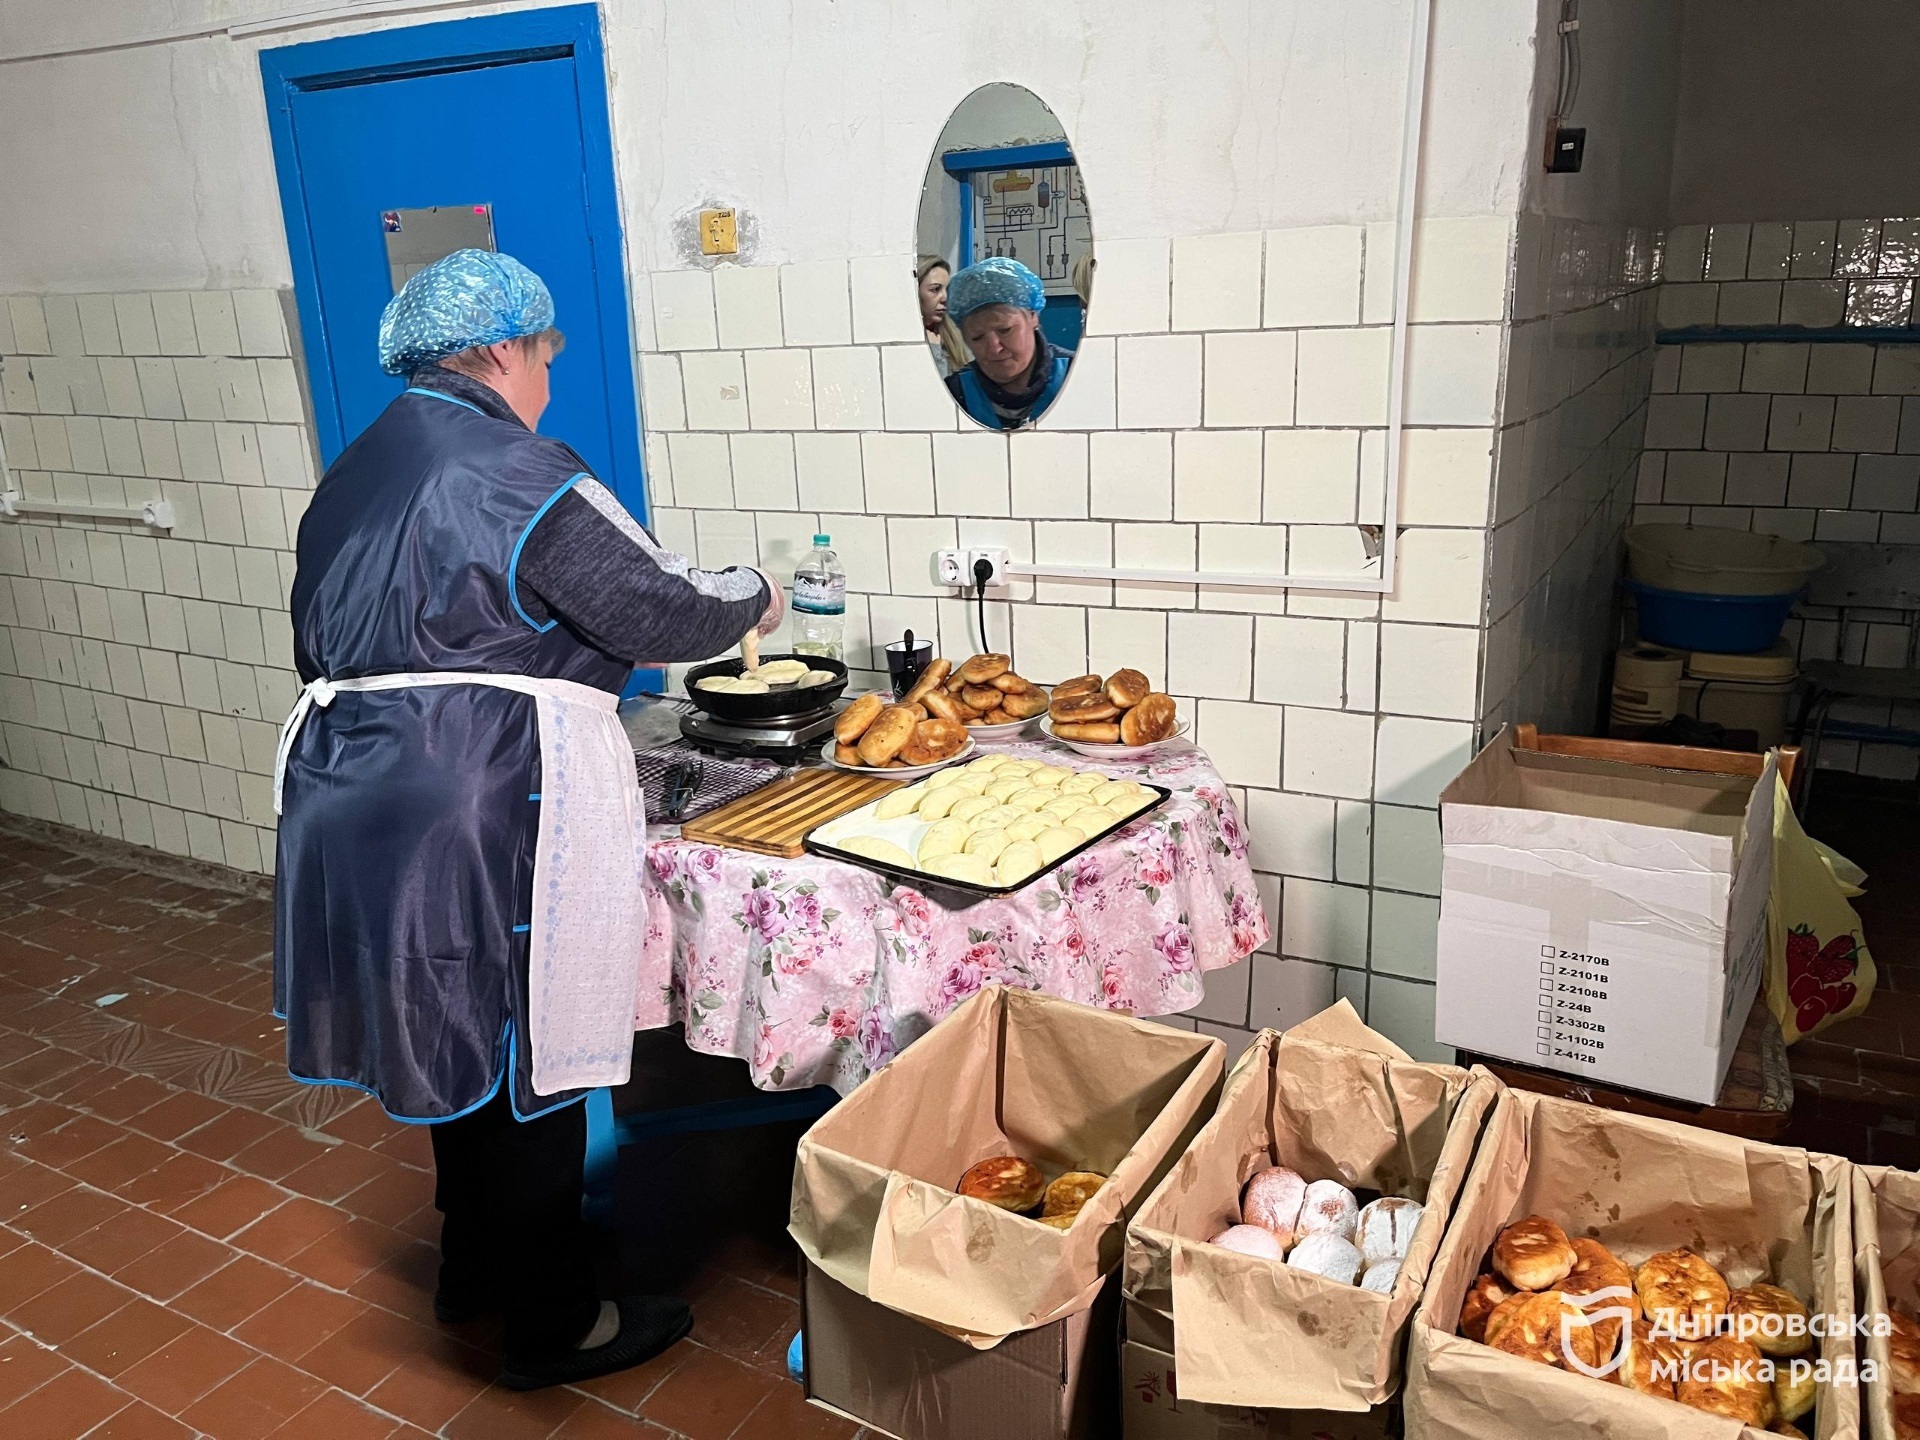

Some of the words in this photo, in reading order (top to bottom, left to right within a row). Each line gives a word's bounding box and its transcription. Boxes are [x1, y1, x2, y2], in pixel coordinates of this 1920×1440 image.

[1559, 950, 1610, 966] Z-2170B
[1558, 967, 1609, 983] Z-2101B
[1557, 983, 1608, 1000] Z-2108B
[1556, 999, 1592, 1014] Z-24B
[1555, 1015, 1606, 1033] Z-3302B
[1555, 1031, 1605, 1049] Z-1102B
[1554, 1048, 1596, 1064] Z-412B
